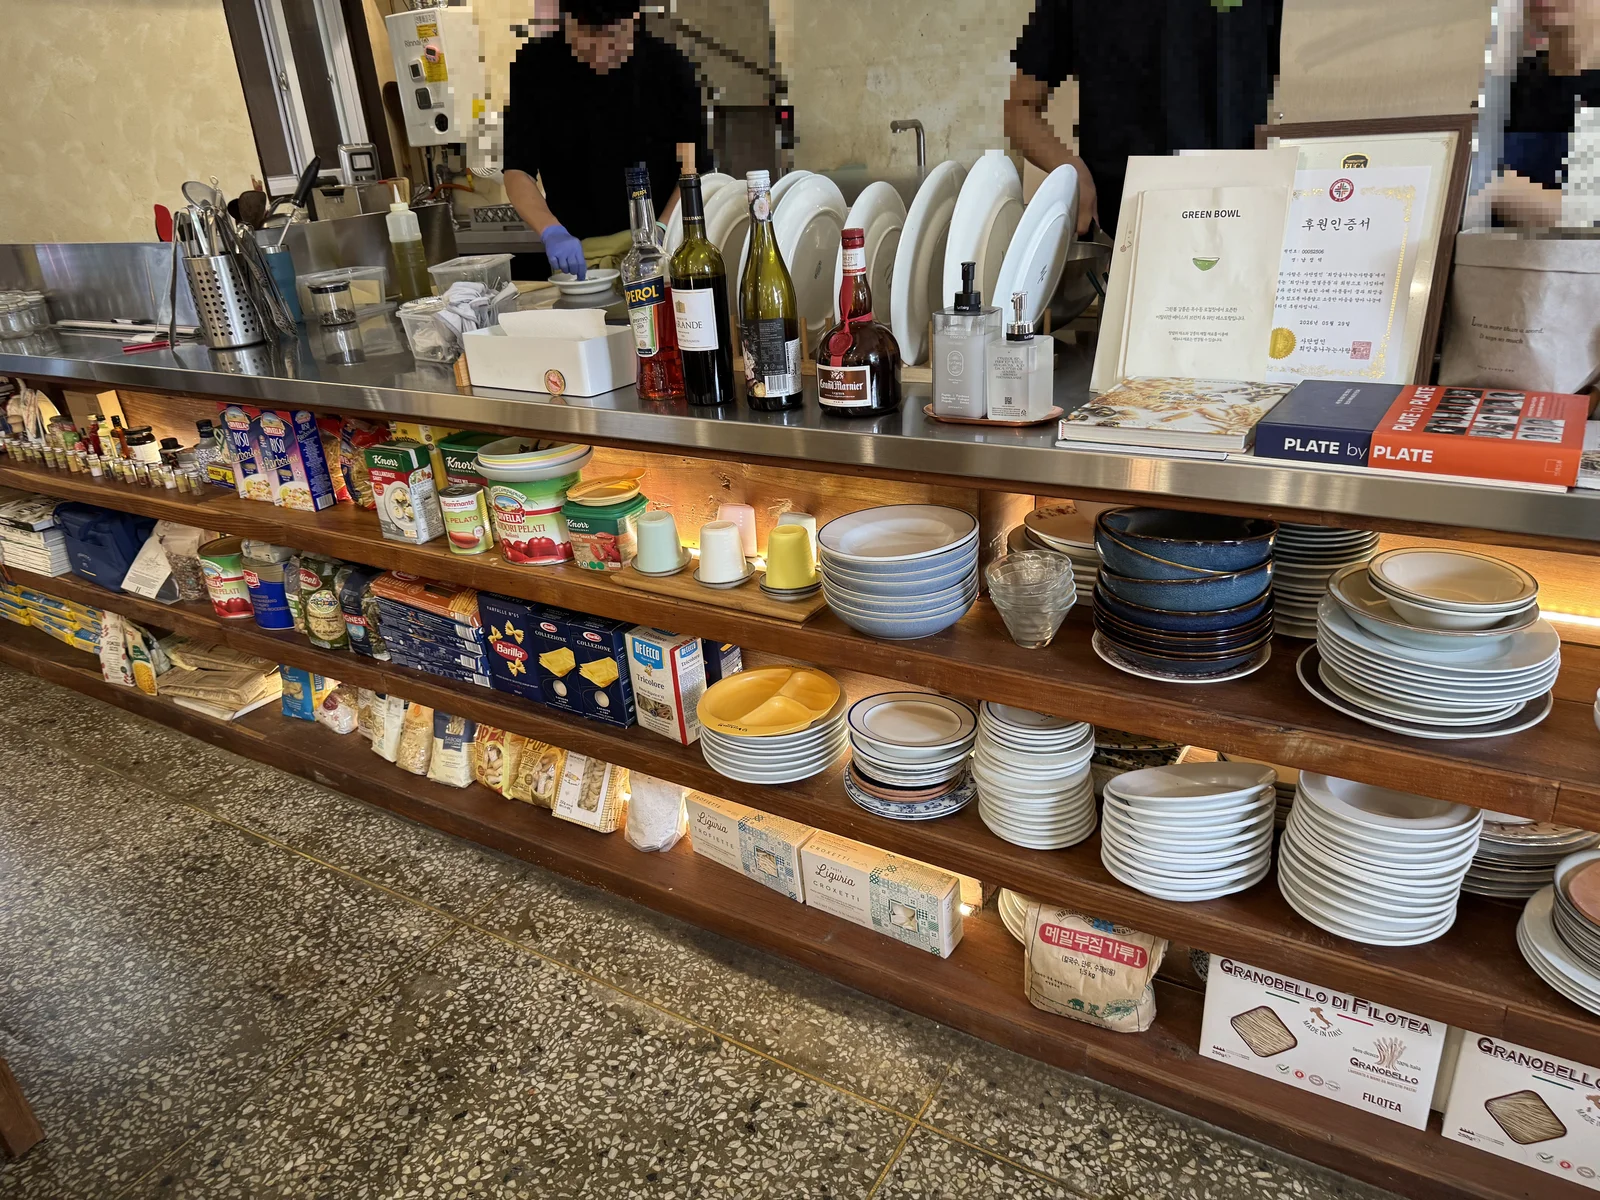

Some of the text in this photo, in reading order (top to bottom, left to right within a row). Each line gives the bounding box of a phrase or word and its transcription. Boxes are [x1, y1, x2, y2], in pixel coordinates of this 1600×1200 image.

[1181, 209, 1241, 219] GREEN BOWL
[1302, 217, 1371, 231] 후원인증서
[835, 380, 864, 391] Marnier
[1392, 413, 1422, 431] PLATE
[1409, 386, 1437, 406] PLATE
[233, 431, 250, 447] RISO
[269, 437, 286, 454] RISO
[230, 448, 260, 464] Parboile
[1284, 437, 1434, 463] PLATE by PLATE
[372, 455, 399, 467] Knorr
[446, 456, 476, 470] Knorr
[450, 515, 479, 524] PELATO
[497, 522, 546, 533] ODORI PELATI
[566, 519, 589, 529] Knorr
[486, 605, 507, 616] FARFALLE
[534, 629, 567, 643] COLLEZIONE
[496, 644, 524, 659] Barilla
[576, 639, 611, 652] COLLEZIONE
[634, 641, 660, 661] DE CECCO
[636, 673, 665, 690] Tricolore
[697, 812, 728, 834] Liguria
[810, 845, 850, 862] CROXETTI
[815, 863, 856, 887] Liguria
[813, 880, 860, 902] CROXETTI
[1088, 971, 1096, 979] kg
[1220, 958, 1432, 1037] GRANOBELLO DI FILOTEA
[1303, 1020, 1319, 1034] MADE
[1327, 1028, 1343, 1038] ITALY
[1350, 1057, 1419, 1085] GRANOBELLO
[1363, 1092, 1402, 1113] FILOTEA
[1576, 1108, 1596, 1126] MADE
